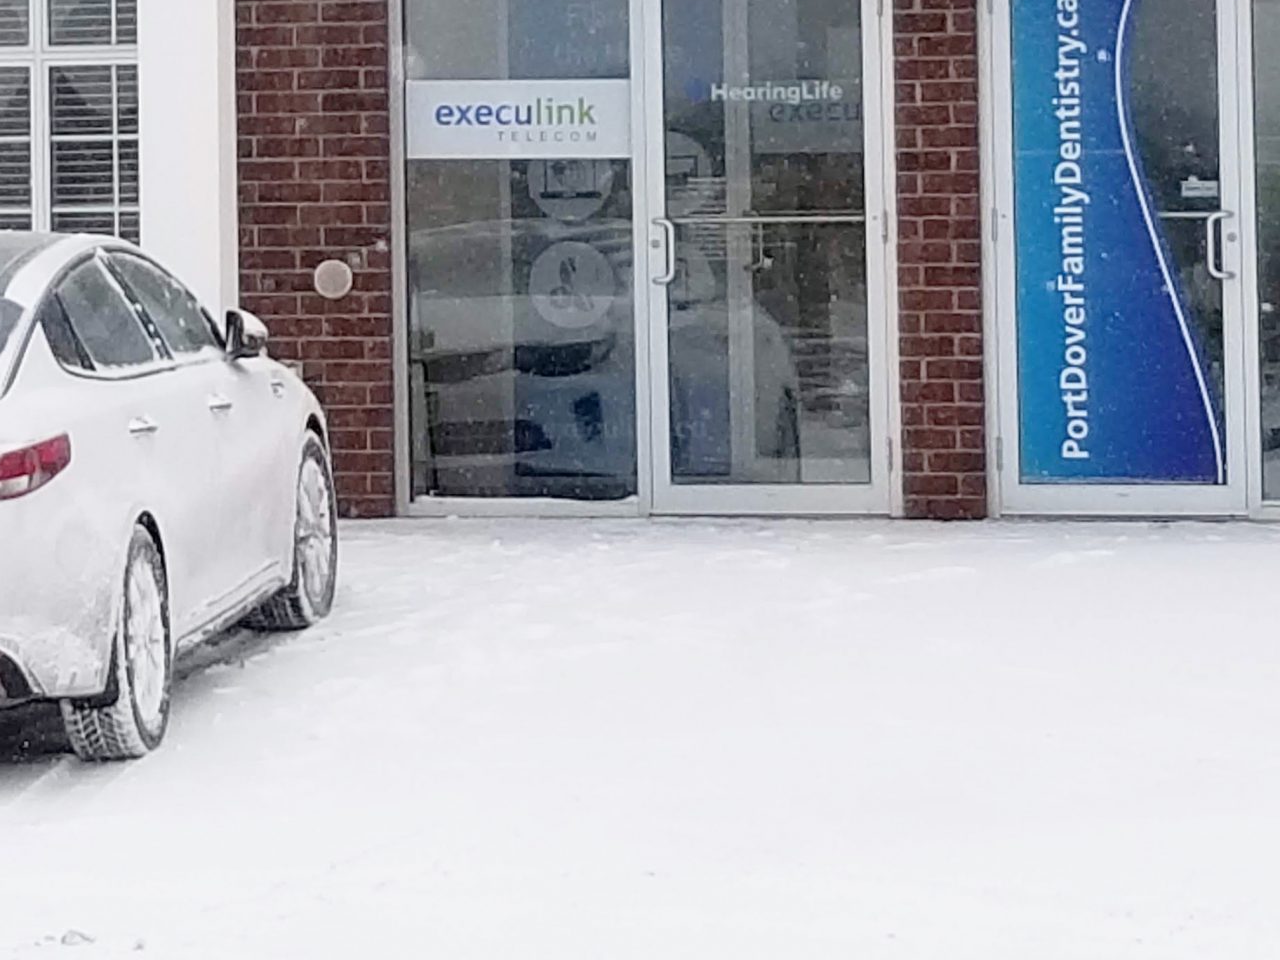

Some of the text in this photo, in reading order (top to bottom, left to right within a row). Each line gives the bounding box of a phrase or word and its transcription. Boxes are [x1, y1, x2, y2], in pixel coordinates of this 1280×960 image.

[710, 80, 844, 105] HearingLife
[435, 97, 597, 126] execulink
[497, 130, 598, 142] TELECOM
